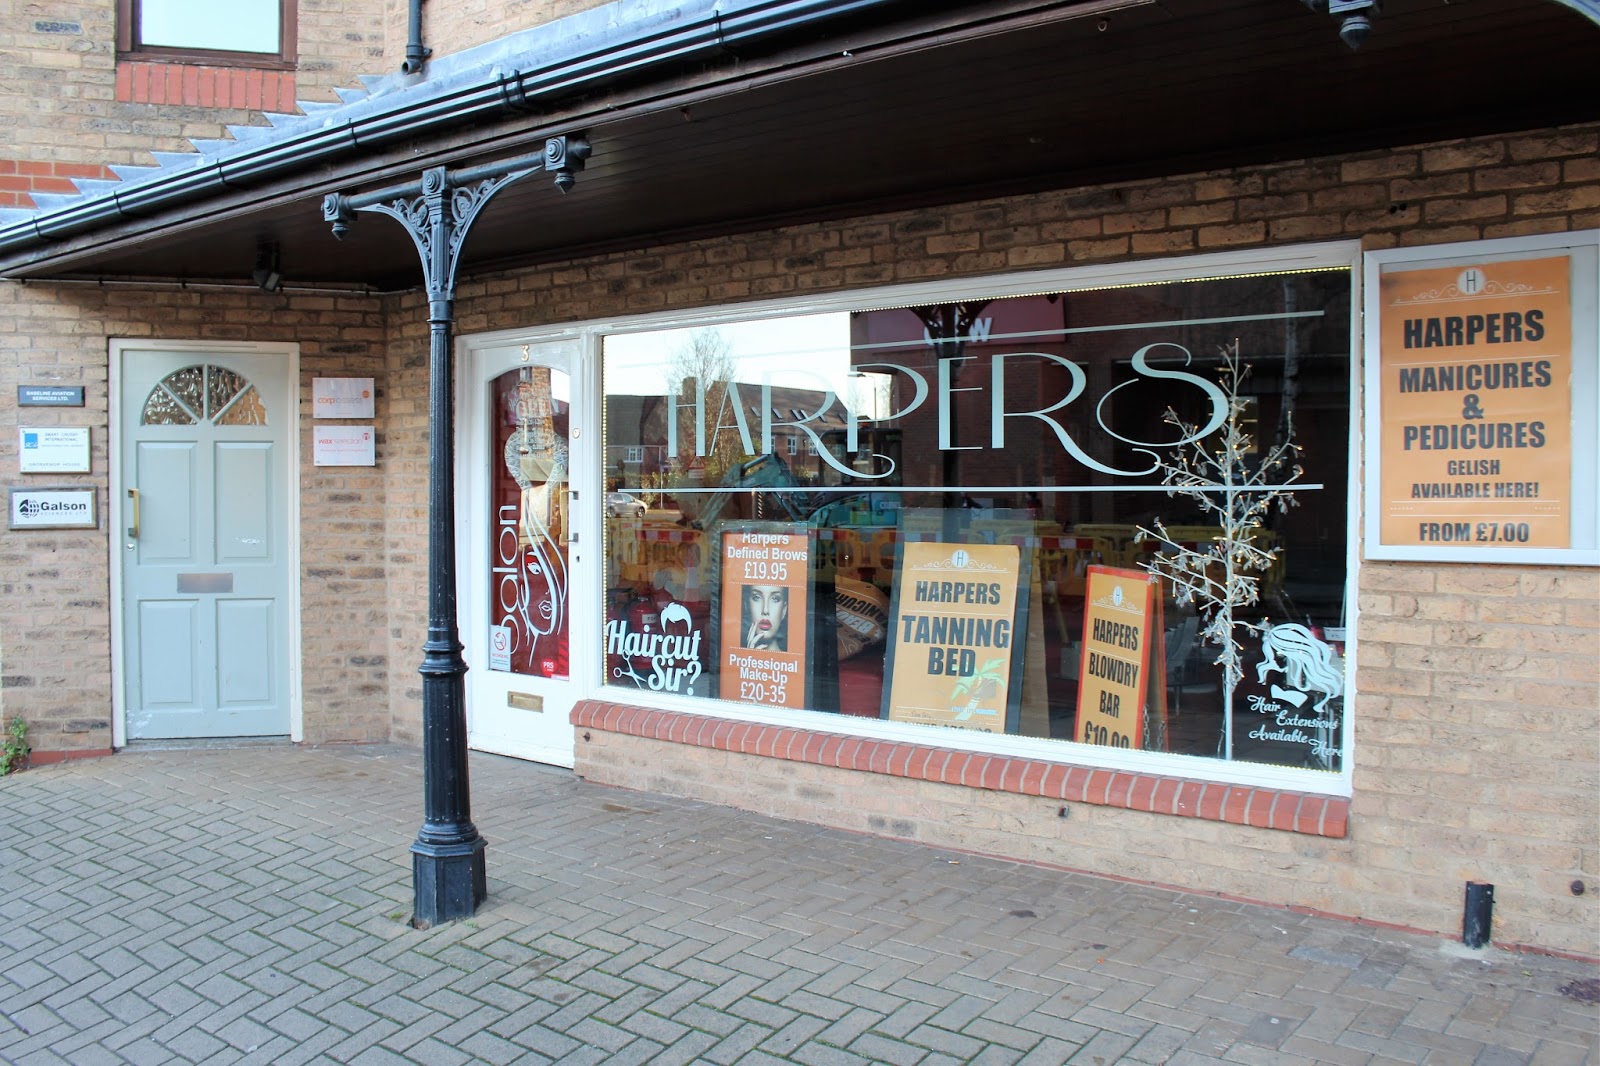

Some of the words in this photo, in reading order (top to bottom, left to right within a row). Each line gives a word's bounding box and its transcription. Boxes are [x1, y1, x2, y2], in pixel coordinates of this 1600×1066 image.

[1403, 309, 1545, 349] HARPERS
[521, 344, 530, 362] 3
[1399, 360, 1552, 393] MANICURES
[668, 342, 1230, 480] HARPERS
[1462, 394, 1484, 420] &
[1403, 421, 1546, 451] PEDICURES
[1447, 459, 1500, 476] GELISH
[1411, 484, 1490, 499] AVAILABLE
[1494, 481, 1539, 498] HERE!
[40, 501, 87, 512] Galson
[742, 533, 790, 547] Harpers
[1419, 522, 1470, 542] FROM
[1476, 522, 1529, 542] £7.00
[727, 546, 769, 560] Defined
[771, 548, 808, 561] Brows
[744, 561, 788, 581] £19.95
[915, 580, 1000, 605] HARPERS
[606, 620, 702, 661] Haircut
[902, 615, 1011, 649] TANNING
[1093, 618, 1138, 651] HARPERS
[729, 654, 798, 672] Professional
[927, 646, 976, 677] BED
[1088, 652, 1138, 688] BLOWDRY
[648, 655, 702, 696] Sir?
[739, 667, 788, 685] Make-Up
[740, 682, 786, 703] £20-35
[1099, 690, 1120, 719] BAR
[1247, 695, 1281, 714] Hair
[1275, 709, 1338, 730] Extensions
[1248, 724, 1309, 744] Available
[1308, 739, 1344, 758] Here
